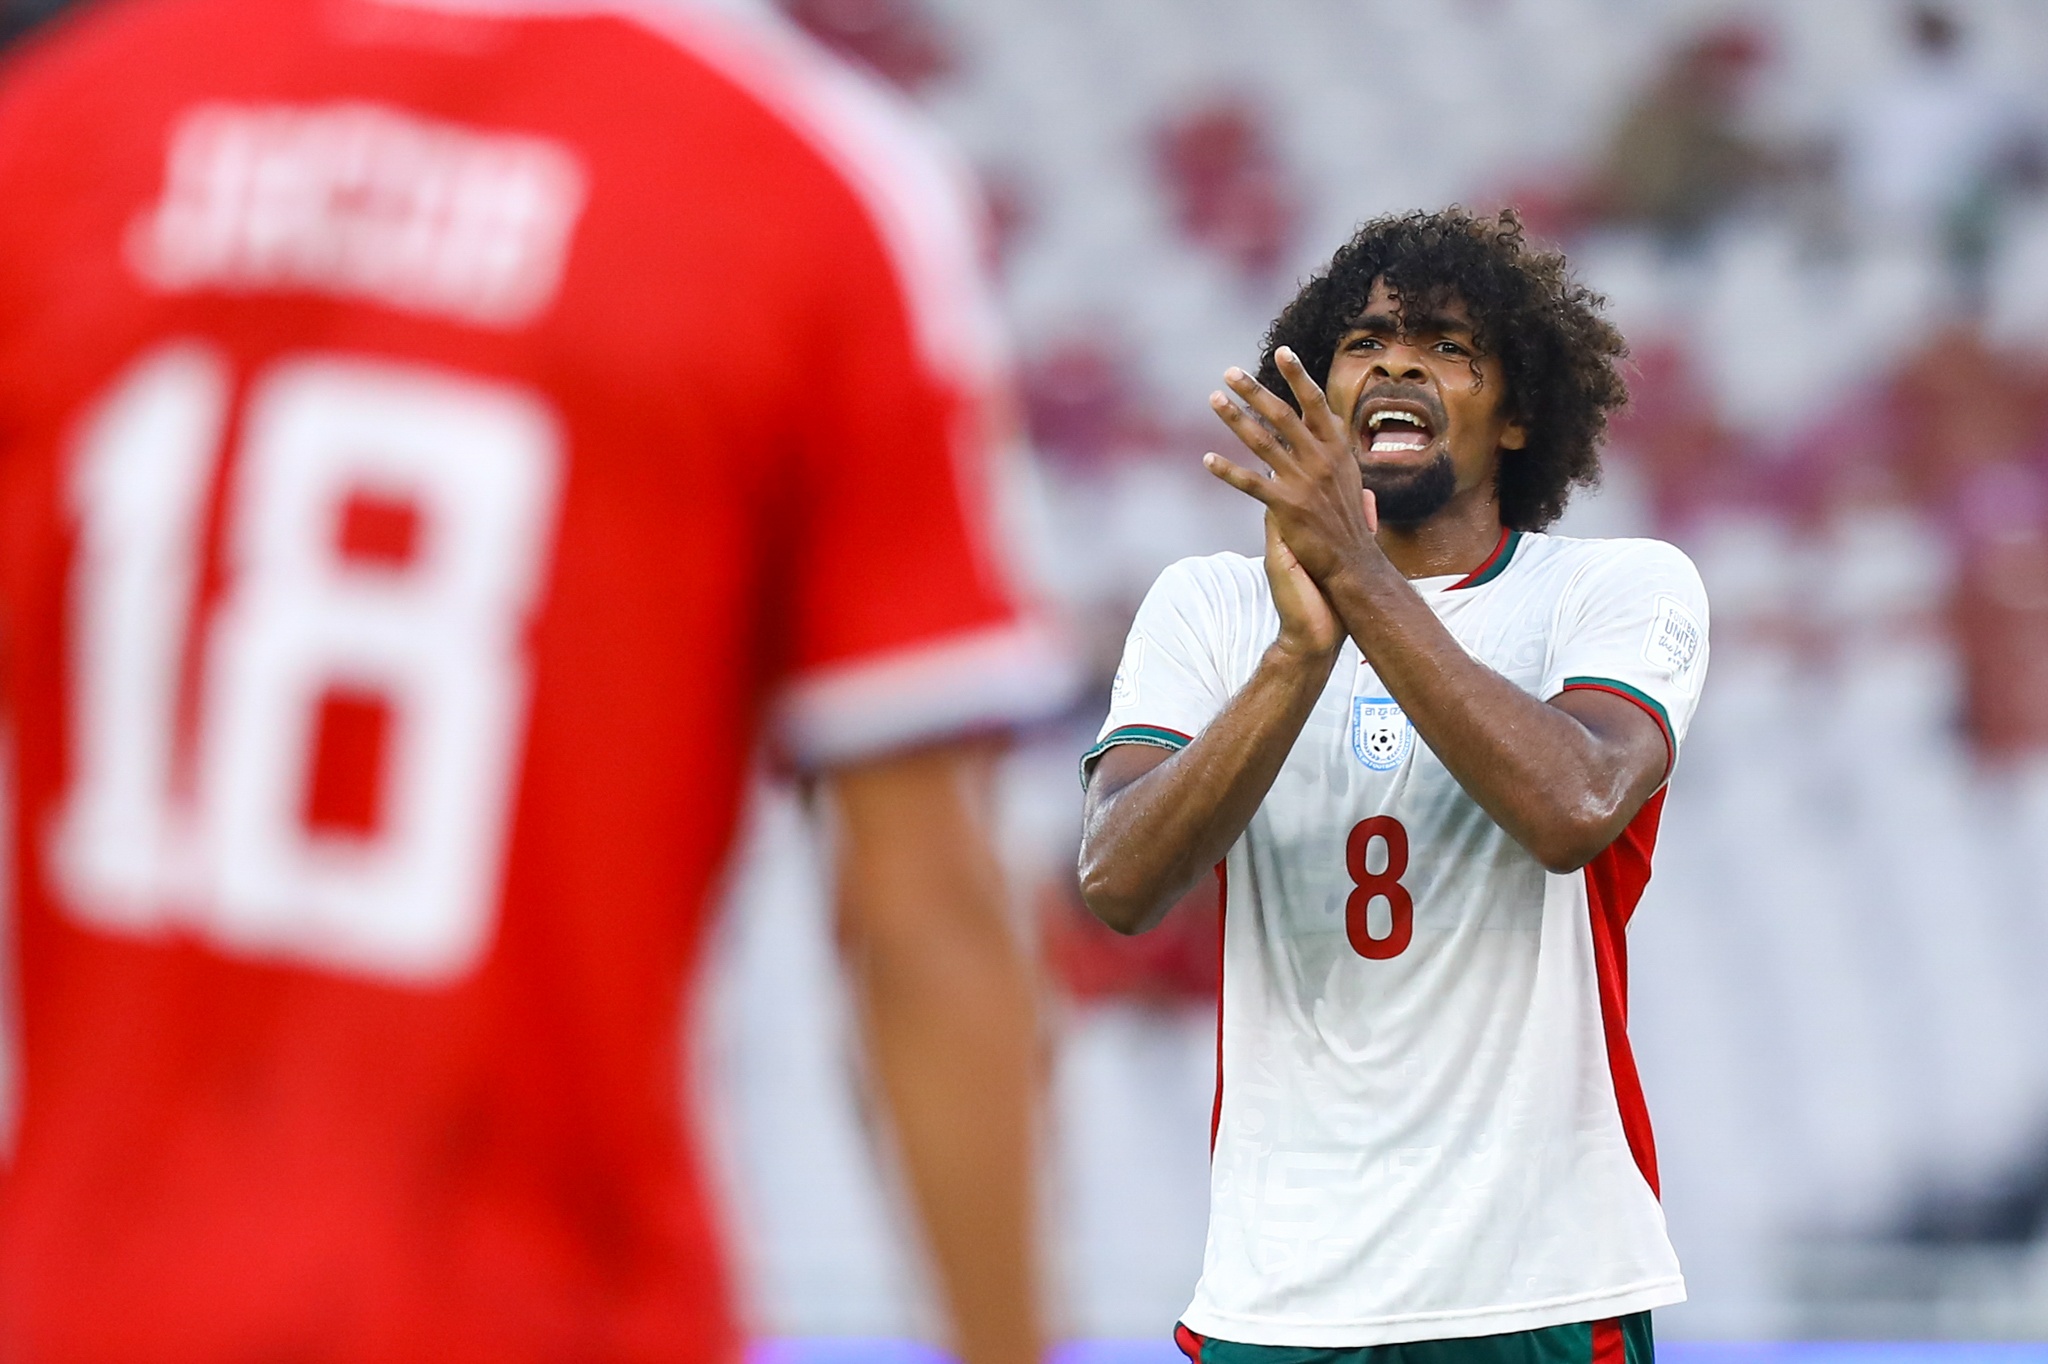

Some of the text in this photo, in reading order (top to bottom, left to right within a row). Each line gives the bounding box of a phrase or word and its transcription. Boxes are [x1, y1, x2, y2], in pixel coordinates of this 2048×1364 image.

[48, 345, 564, 985] 18
[1664, 618, 1697, 654] UNITE
[1346, 815, 1413, 960] 8
